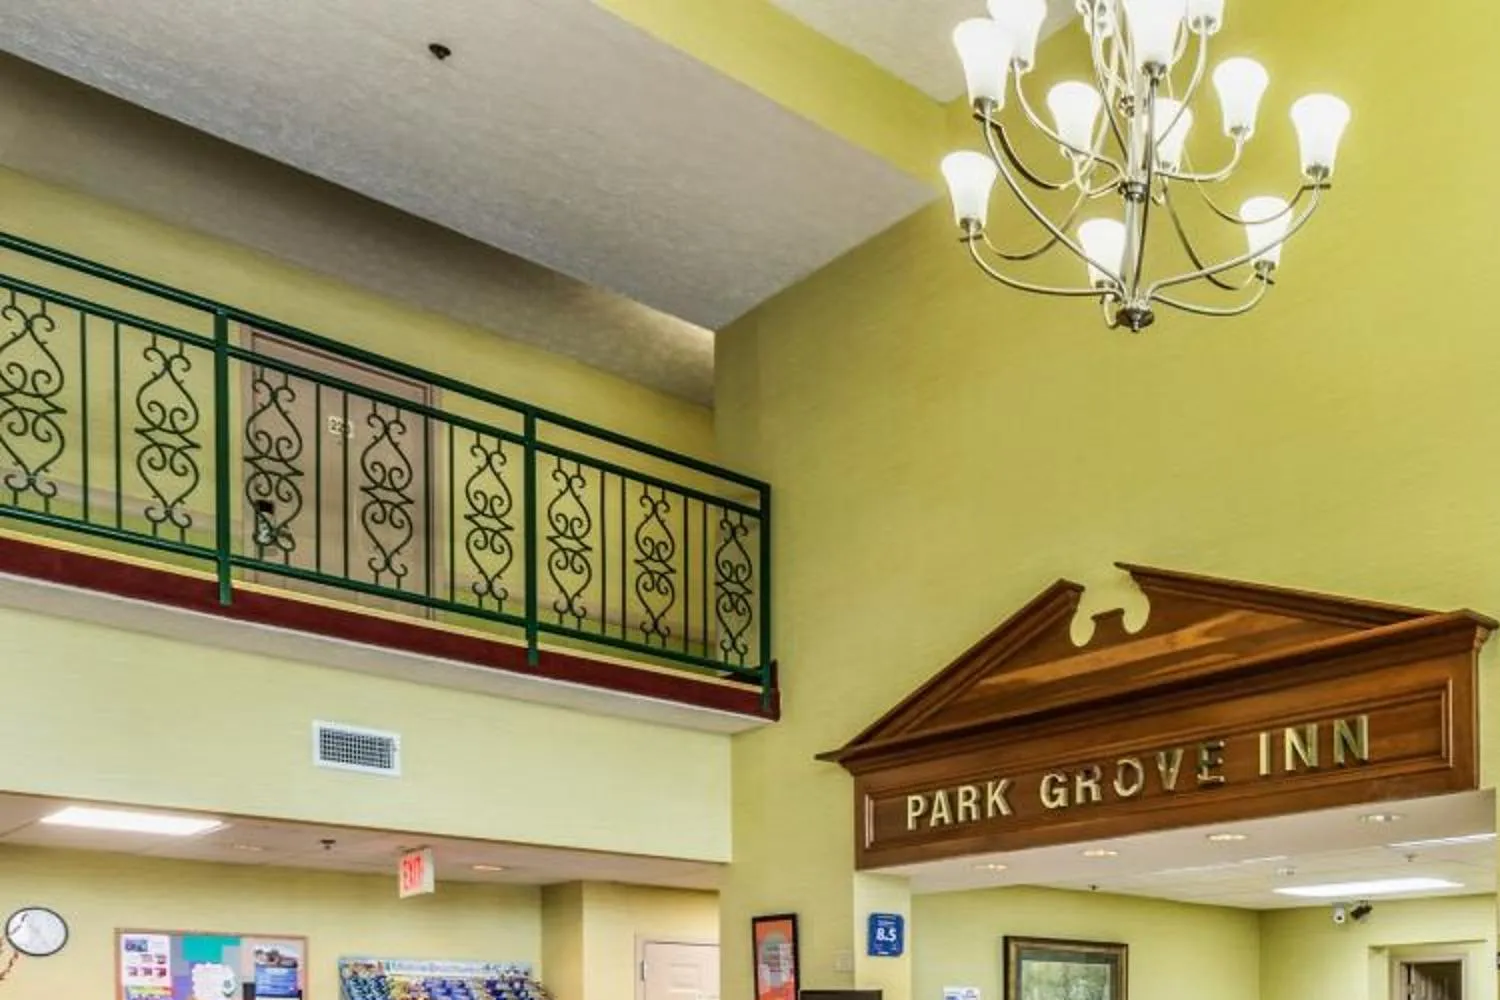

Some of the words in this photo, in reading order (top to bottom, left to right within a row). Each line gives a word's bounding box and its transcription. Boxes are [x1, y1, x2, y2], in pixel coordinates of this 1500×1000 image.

[906, 777, 1014, 831] PARK
[1039, 739, 1226, 810] GROVE
[1258, 714, 1369, 776] INN
[876, 928, 896, 942] 8.5
